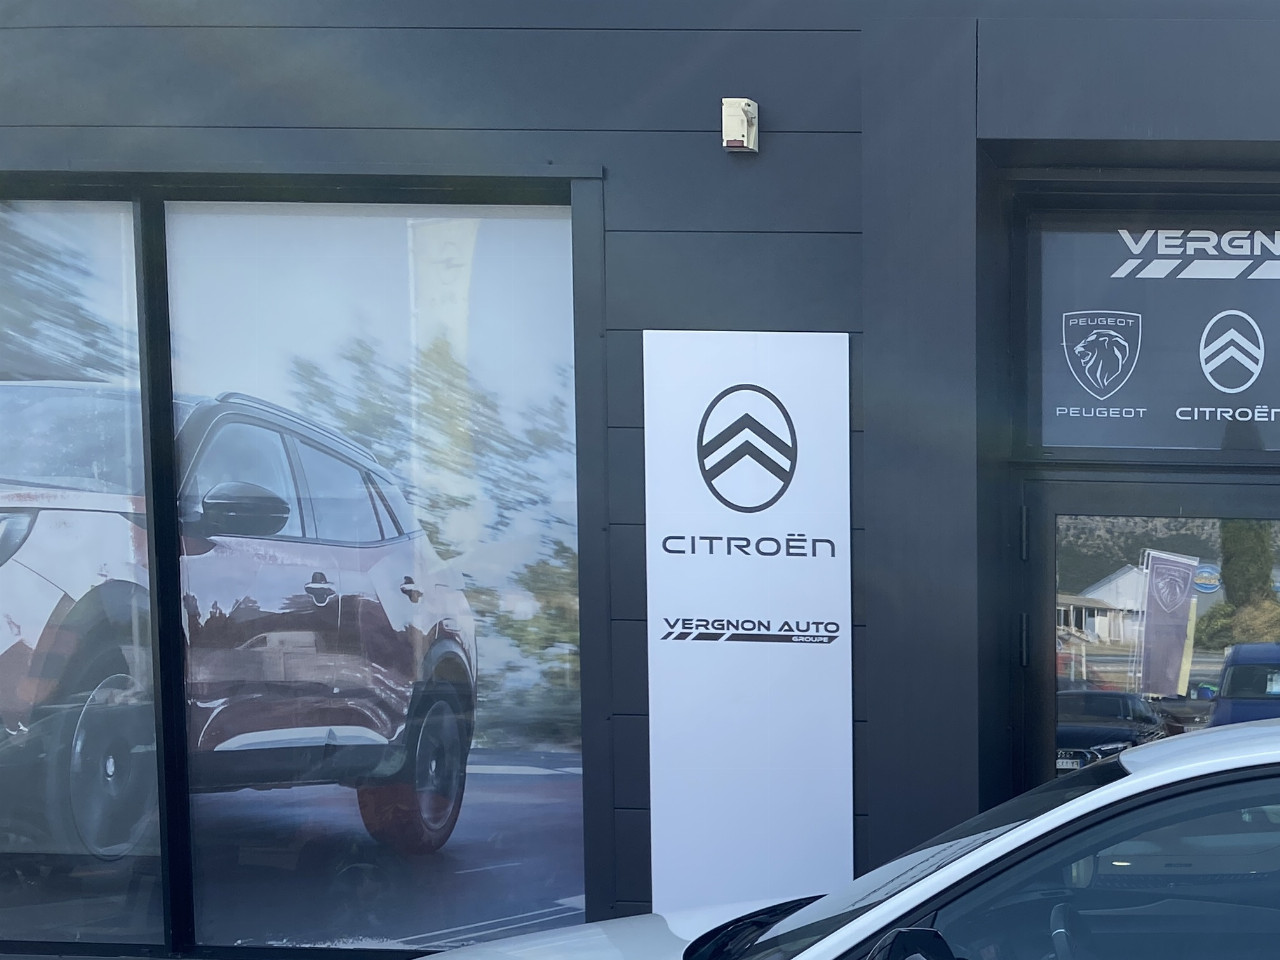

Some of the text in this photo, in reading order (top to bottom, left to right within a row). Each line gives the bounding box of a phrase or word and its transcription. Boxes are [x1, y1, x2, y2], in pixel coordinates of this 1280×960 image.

[1069, 317, 1135, 327] PEUGEOT
[1056, 406, 1147, 419] PEUGEOT
[663, 617, 840, 634] VERGNON AUTO
